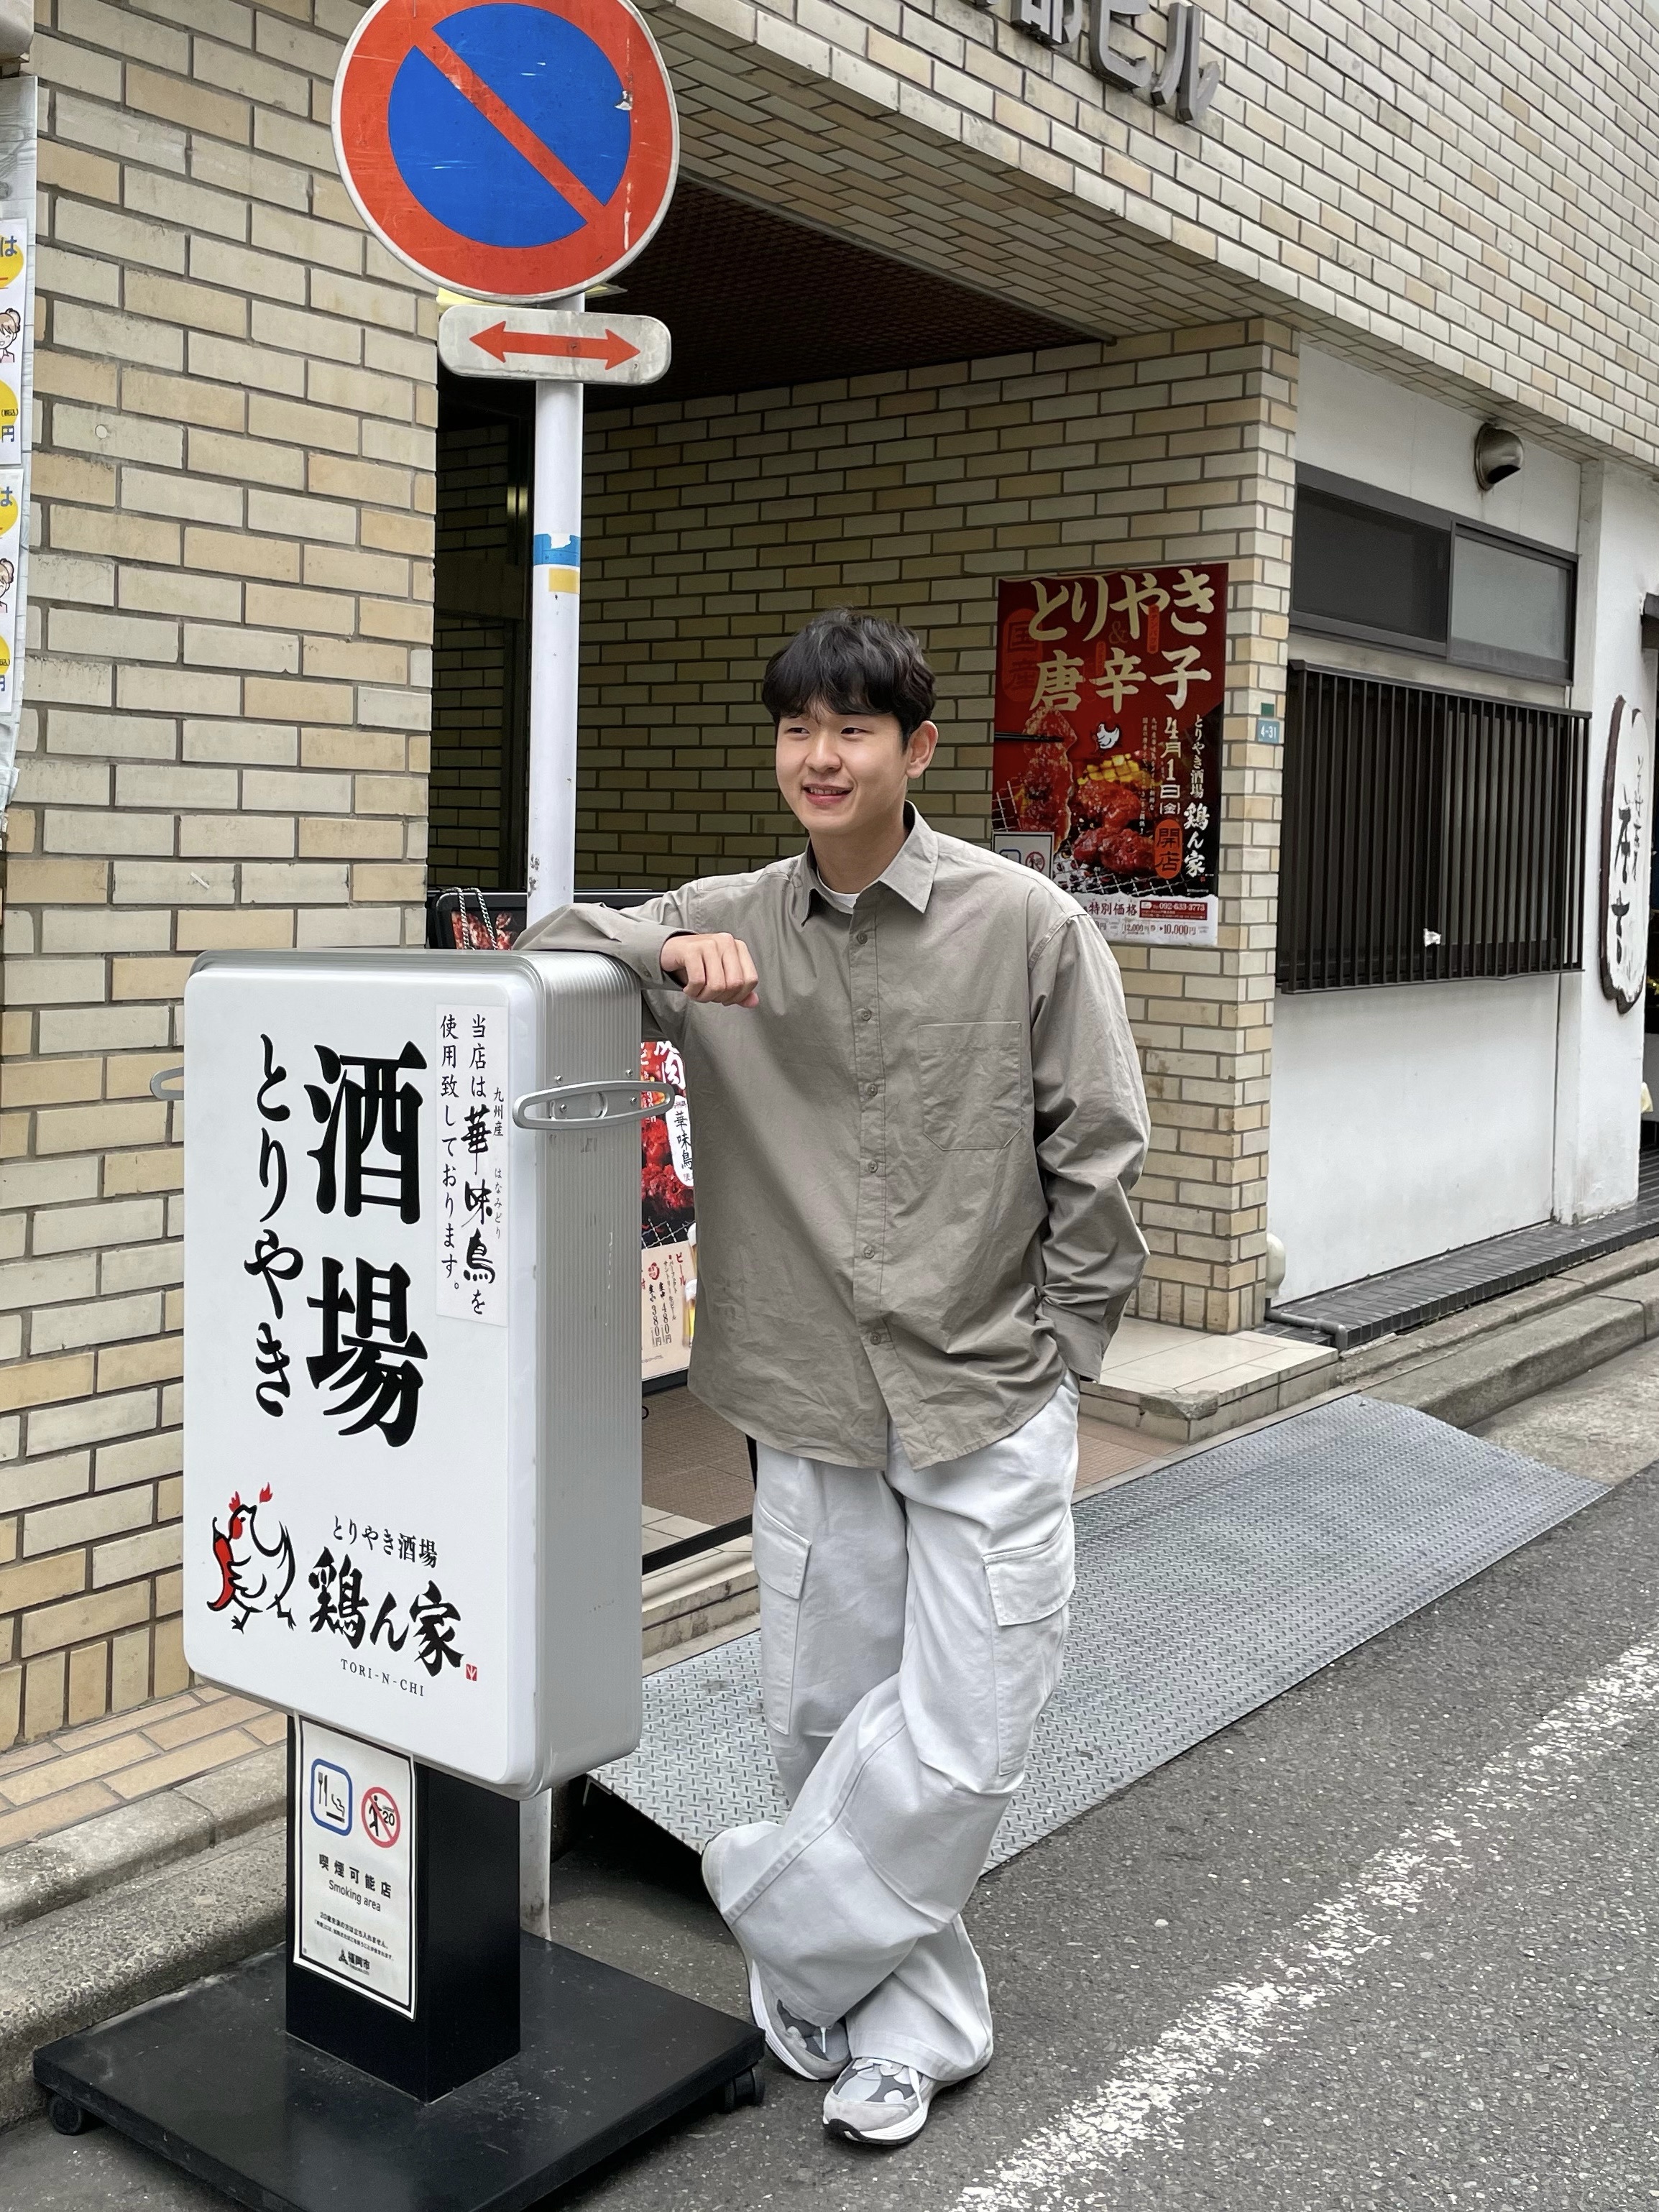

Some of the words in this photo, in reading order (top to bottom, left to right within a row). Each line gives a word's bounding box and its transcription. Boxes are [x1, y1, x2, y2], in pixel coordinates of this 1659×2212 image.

[1029, 569, 1215, 642] とりやき
[1029, 645, 1212, 714] 唐辛子
[1190, 714, 1205, 799] とりやき酒場
[1260, 725, 1277, 739] 4-31
[1155, 828, 1180, 872] 開店
[1184, 803, 1210, 877] 鶏ん家
[1084, 901, 1137, 916] 特別価格
[493, 1087, 504, 1137] 九州産
[440, 1013, 459, 1290] 使用致しております。
[461, 1013, 495, 1315] 当店は華味鳥を
[244, 1033, 304, 1417] とりやき
[494, 1168, 503, 1240] はなみどり
[303, 1041, 428, 1447] 酒場
[676, 1252, 686, 1286] ビール
[333, 1515, 438, 1569] とりやき酒場
[308, 1546, 464, 1677] 鶏ん家
[341, 1658, 424, 1697] TORI-N-CHI
[382, 1810, 395, 1826] 20
[319, 1853, 391, 1899] 喫煙可能店
[328, 1879, 362, 1905] Smoking
[363, 1897, 381, 1912] area
